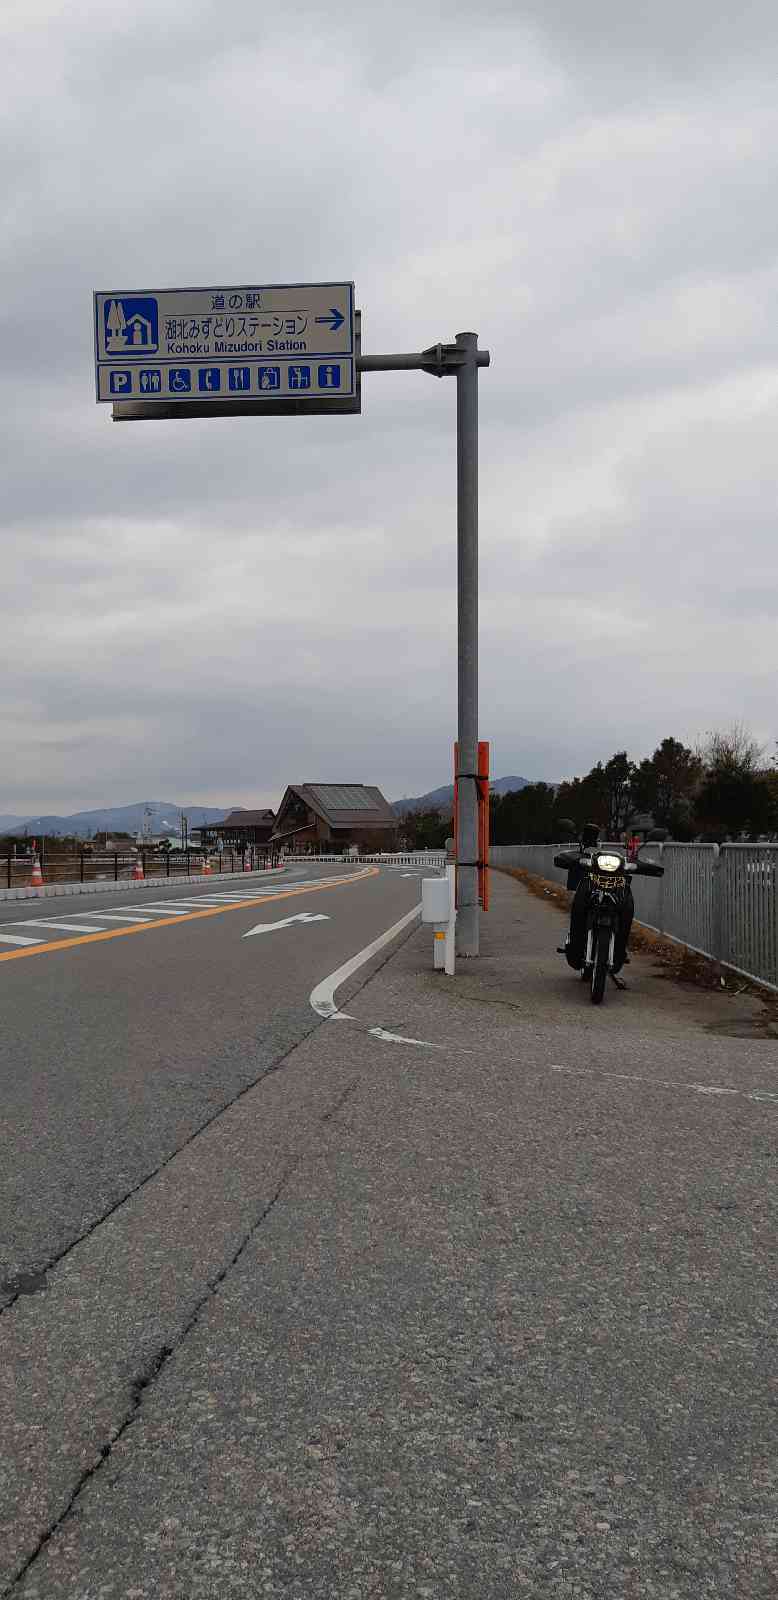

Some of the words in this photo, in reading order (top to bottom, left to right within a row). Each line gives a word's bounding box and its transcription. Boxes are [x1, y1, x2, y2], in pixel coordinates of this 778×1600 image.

[211, 294, 262, 311] 道の駅
[165, 316, 309, 340] 湖北みずどりステーション
[167, 342, 210, 354] Kohoku
[214, 340, 262, 353] Mizudori
[267, 338, 307, 351] Station
[113, 375, 127, 392] P
